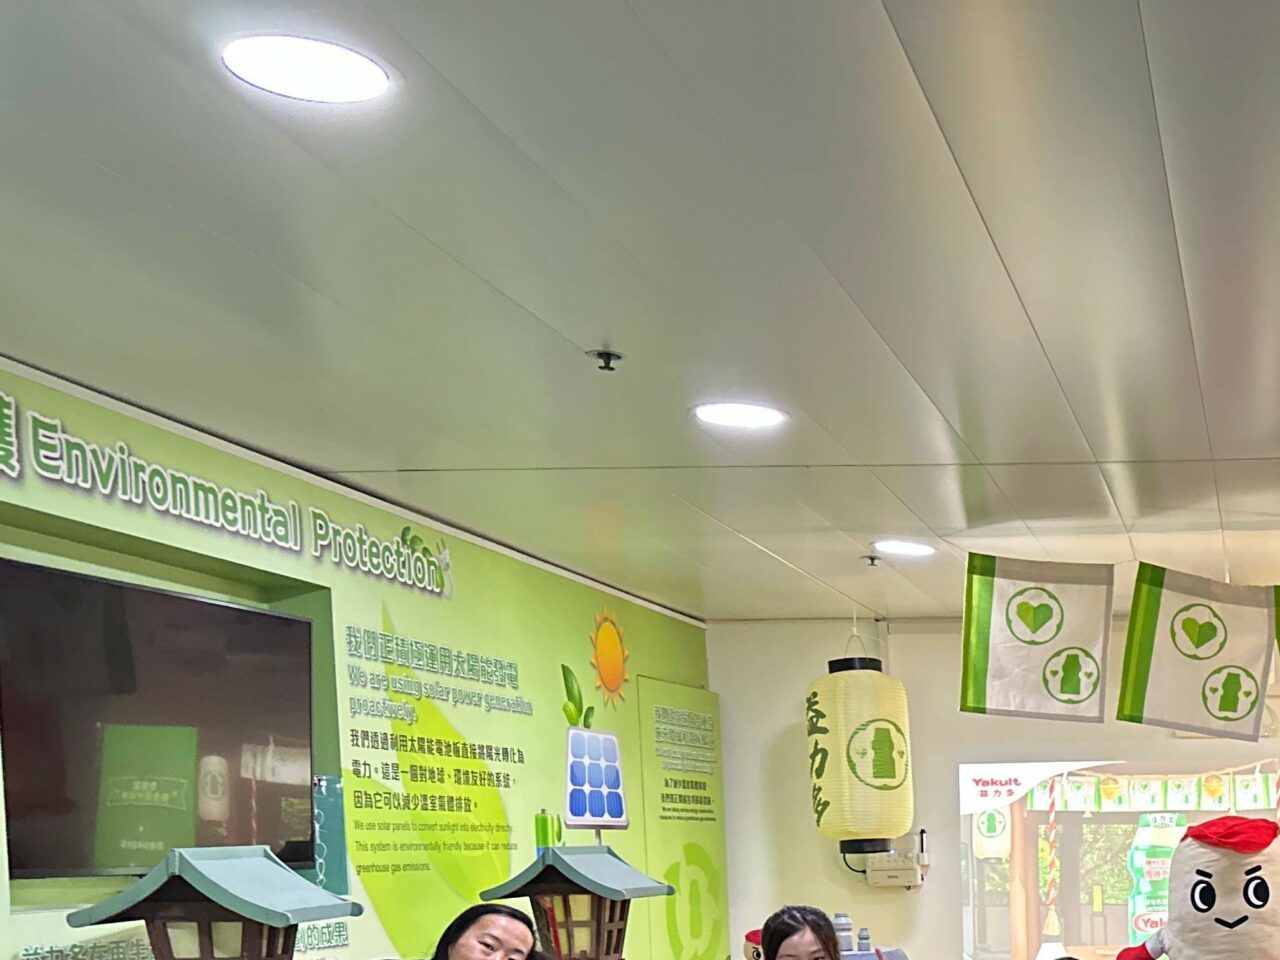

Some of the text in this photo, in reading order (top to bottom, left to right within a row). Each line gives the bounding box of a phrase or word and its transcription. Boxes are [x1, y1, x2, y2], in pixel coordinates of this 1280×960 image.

[29, 411, 301, 551] Environmental
[309, 506, 442, 593] Protection
[348, 664, 532, 715] We are using solar power generation
[806, 691, 830, 828] 益力多
[972, 778, 1021, 787] Yakult
[355, 841, 368, 851] This
[370, 842, 391, 853] system
[356, 863, 390, 875] greenhouse
[391, 863, 401, 874] gas
